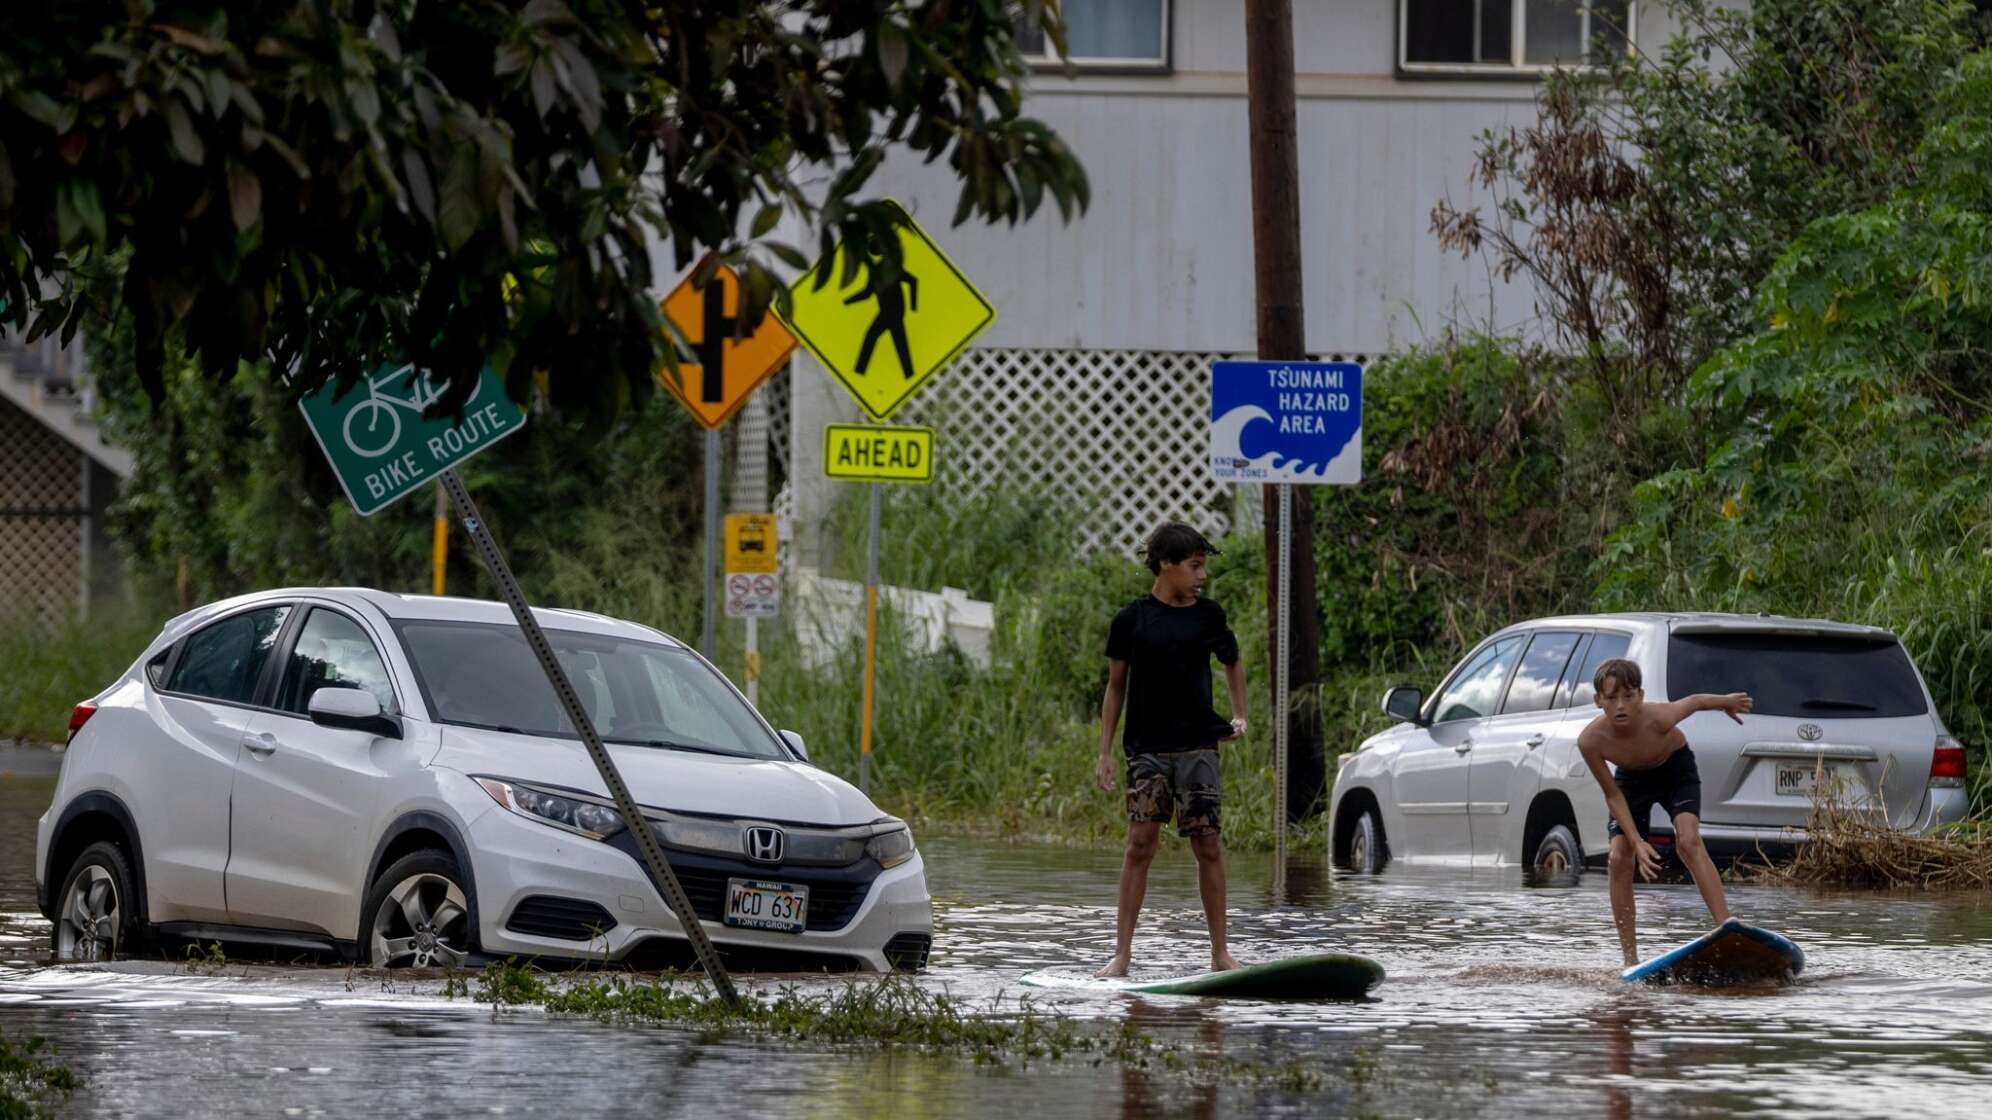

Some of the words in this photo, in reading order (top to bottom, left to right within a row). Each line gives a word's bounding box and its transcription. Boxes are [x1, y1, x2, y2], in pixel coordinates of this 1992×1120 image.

[1267, 369, 1344, 389] TSUNAMI
[1278, 392, 1350, 412] HAZARD
[1279, 415, 1326, 434] AREA
[364, 450, 424, 500] BIKE
[426, 402, 506, 461] ROUTE
[837, 437, 922, 468] AHEAD
[1780, 769, 1803, 788] RNP
[731, 889, 762, 916] WCD
[771, 895, 804, 920] 637
